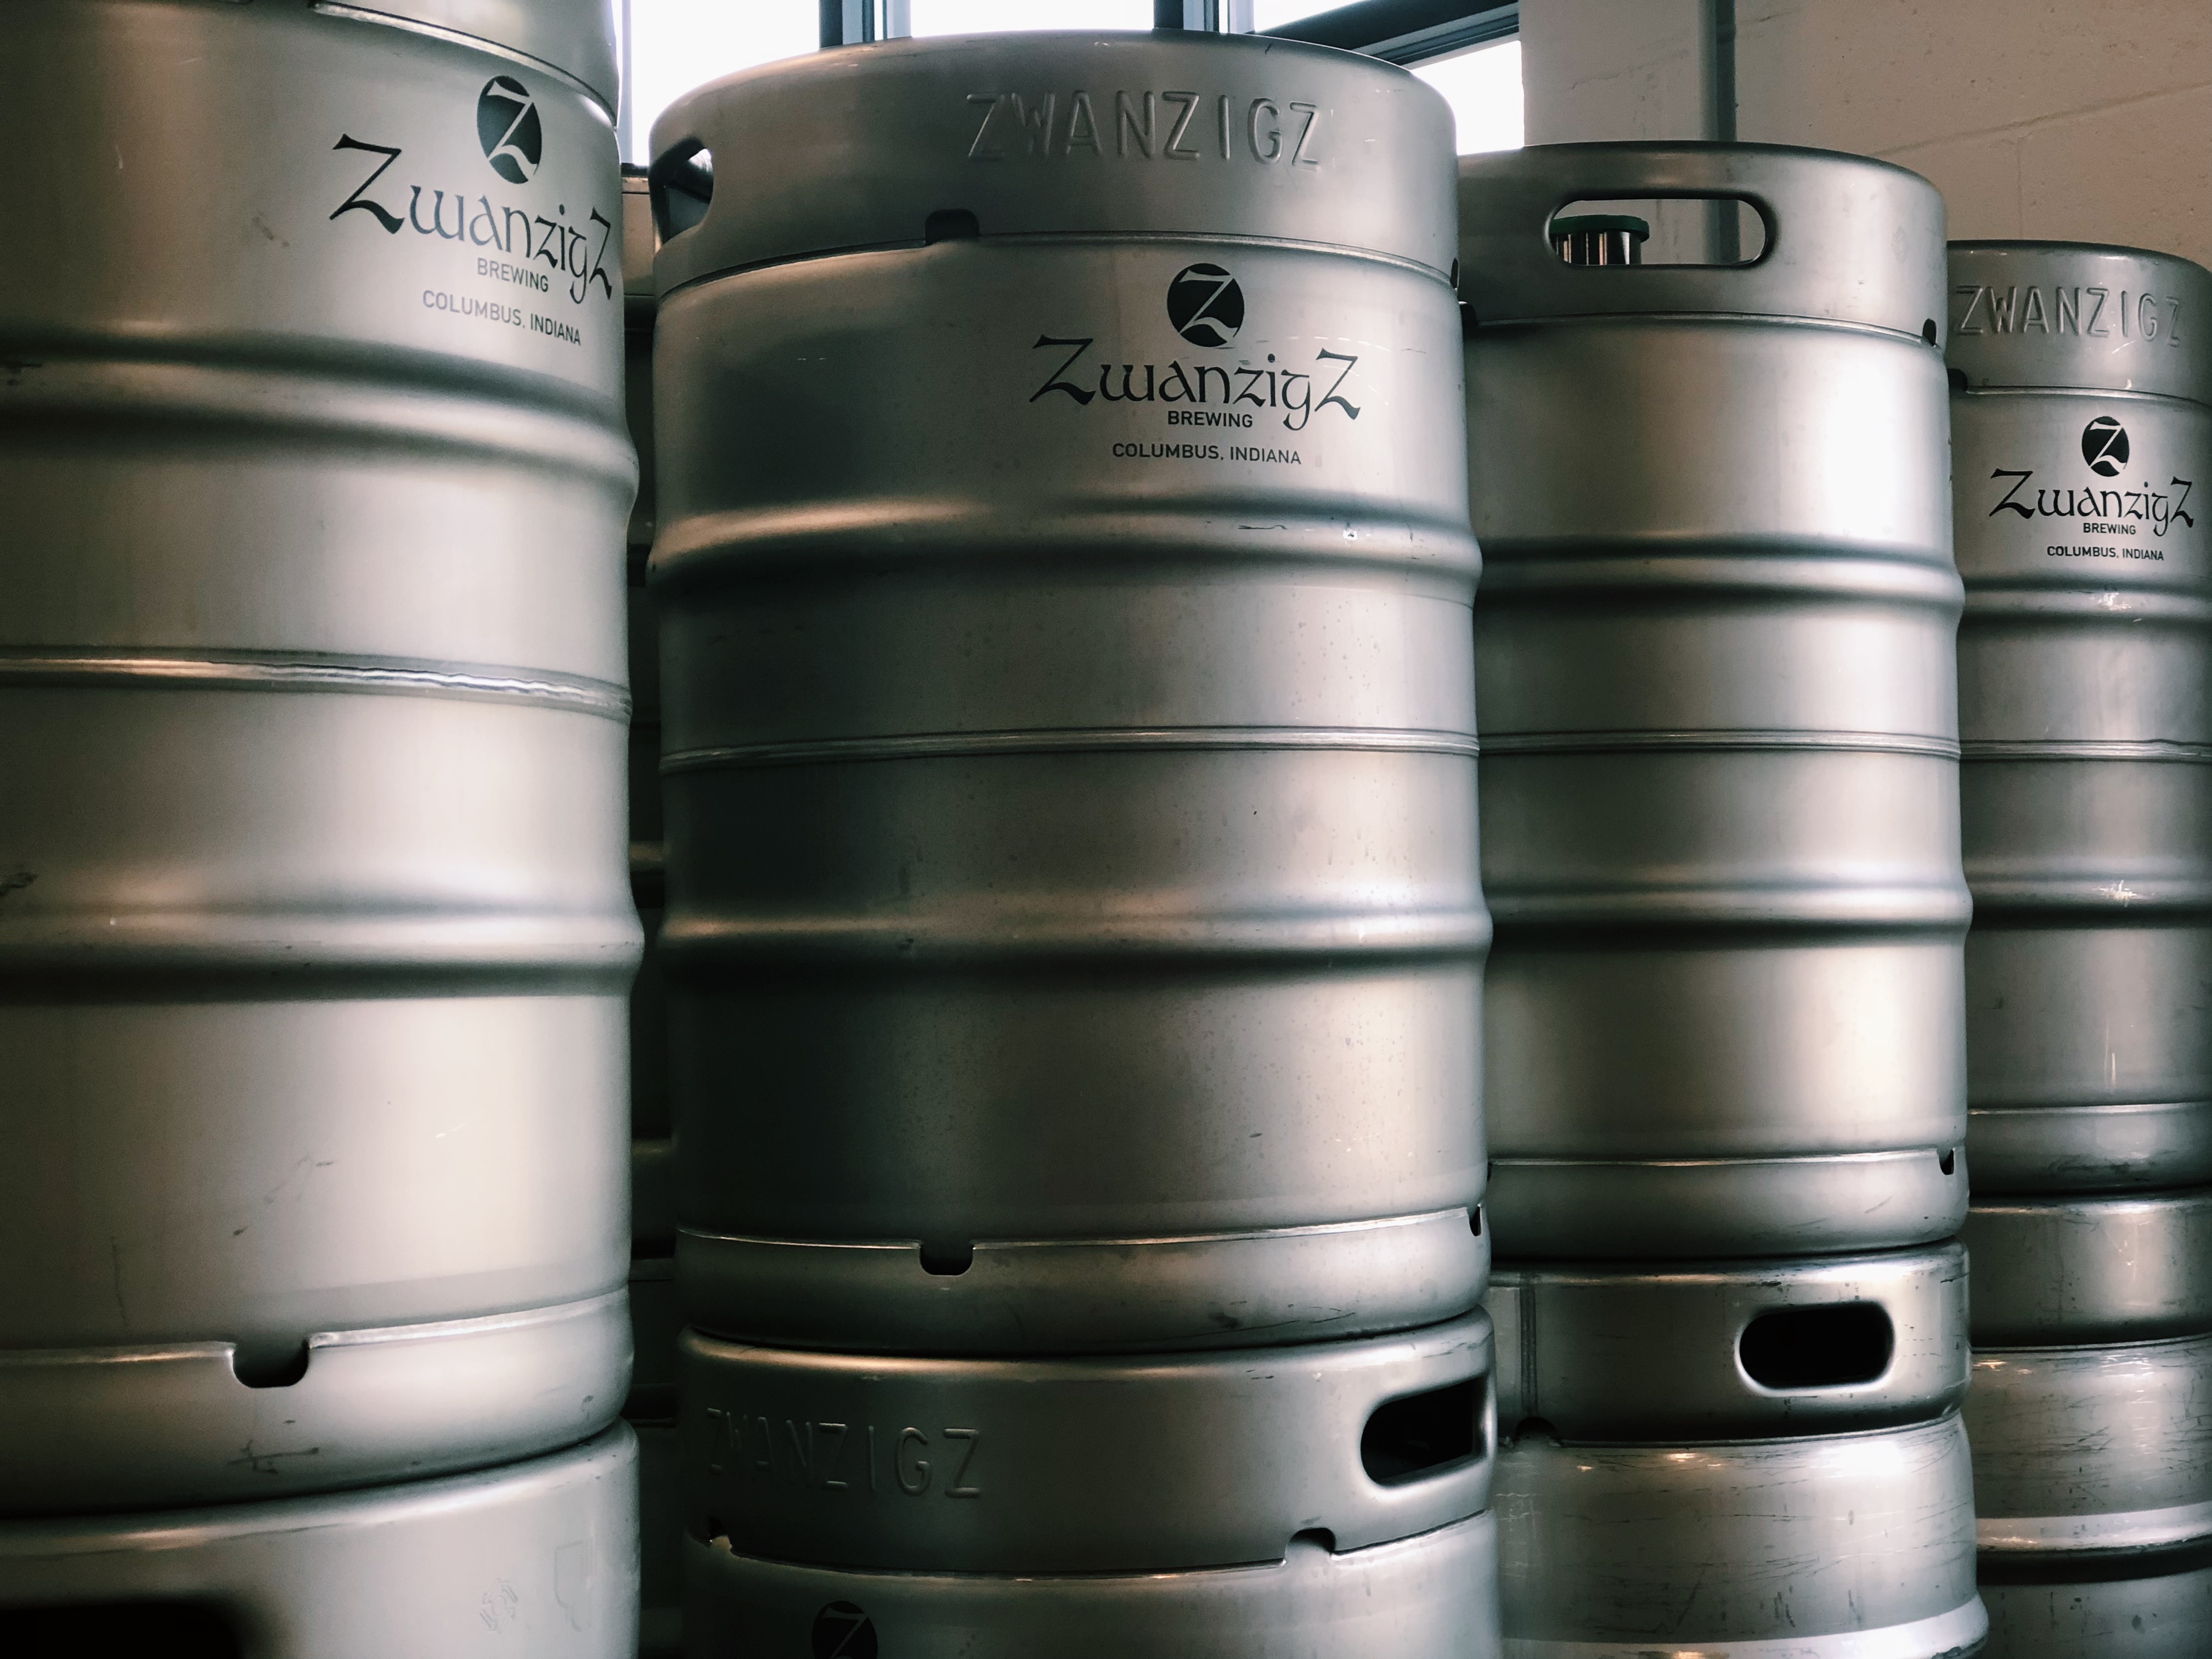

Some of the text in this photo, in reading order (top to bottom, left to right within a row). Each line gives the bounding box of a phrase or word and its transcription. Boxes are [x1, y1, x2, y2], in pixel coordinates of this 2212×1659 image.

[484, 80, 538, 184] Z
[967, 91, 1321, 170] ZWANZIGZ
[477, 258, 549, 293] BREWING
[1177, 268, 1242, 344] Z
[1956, 285, 2181, 347] ZWANZIGZ
[530, 313, 580, 346] INDIANA
[1167, 411, 1254, 428] BREWING
[1230, 447, 1302, 465] INDIANA
[2089, 420, 2129, 474] Z
[2083, 523, 2136, 535] BREWING
[2122, 549, 2164, 561] INDIANA
